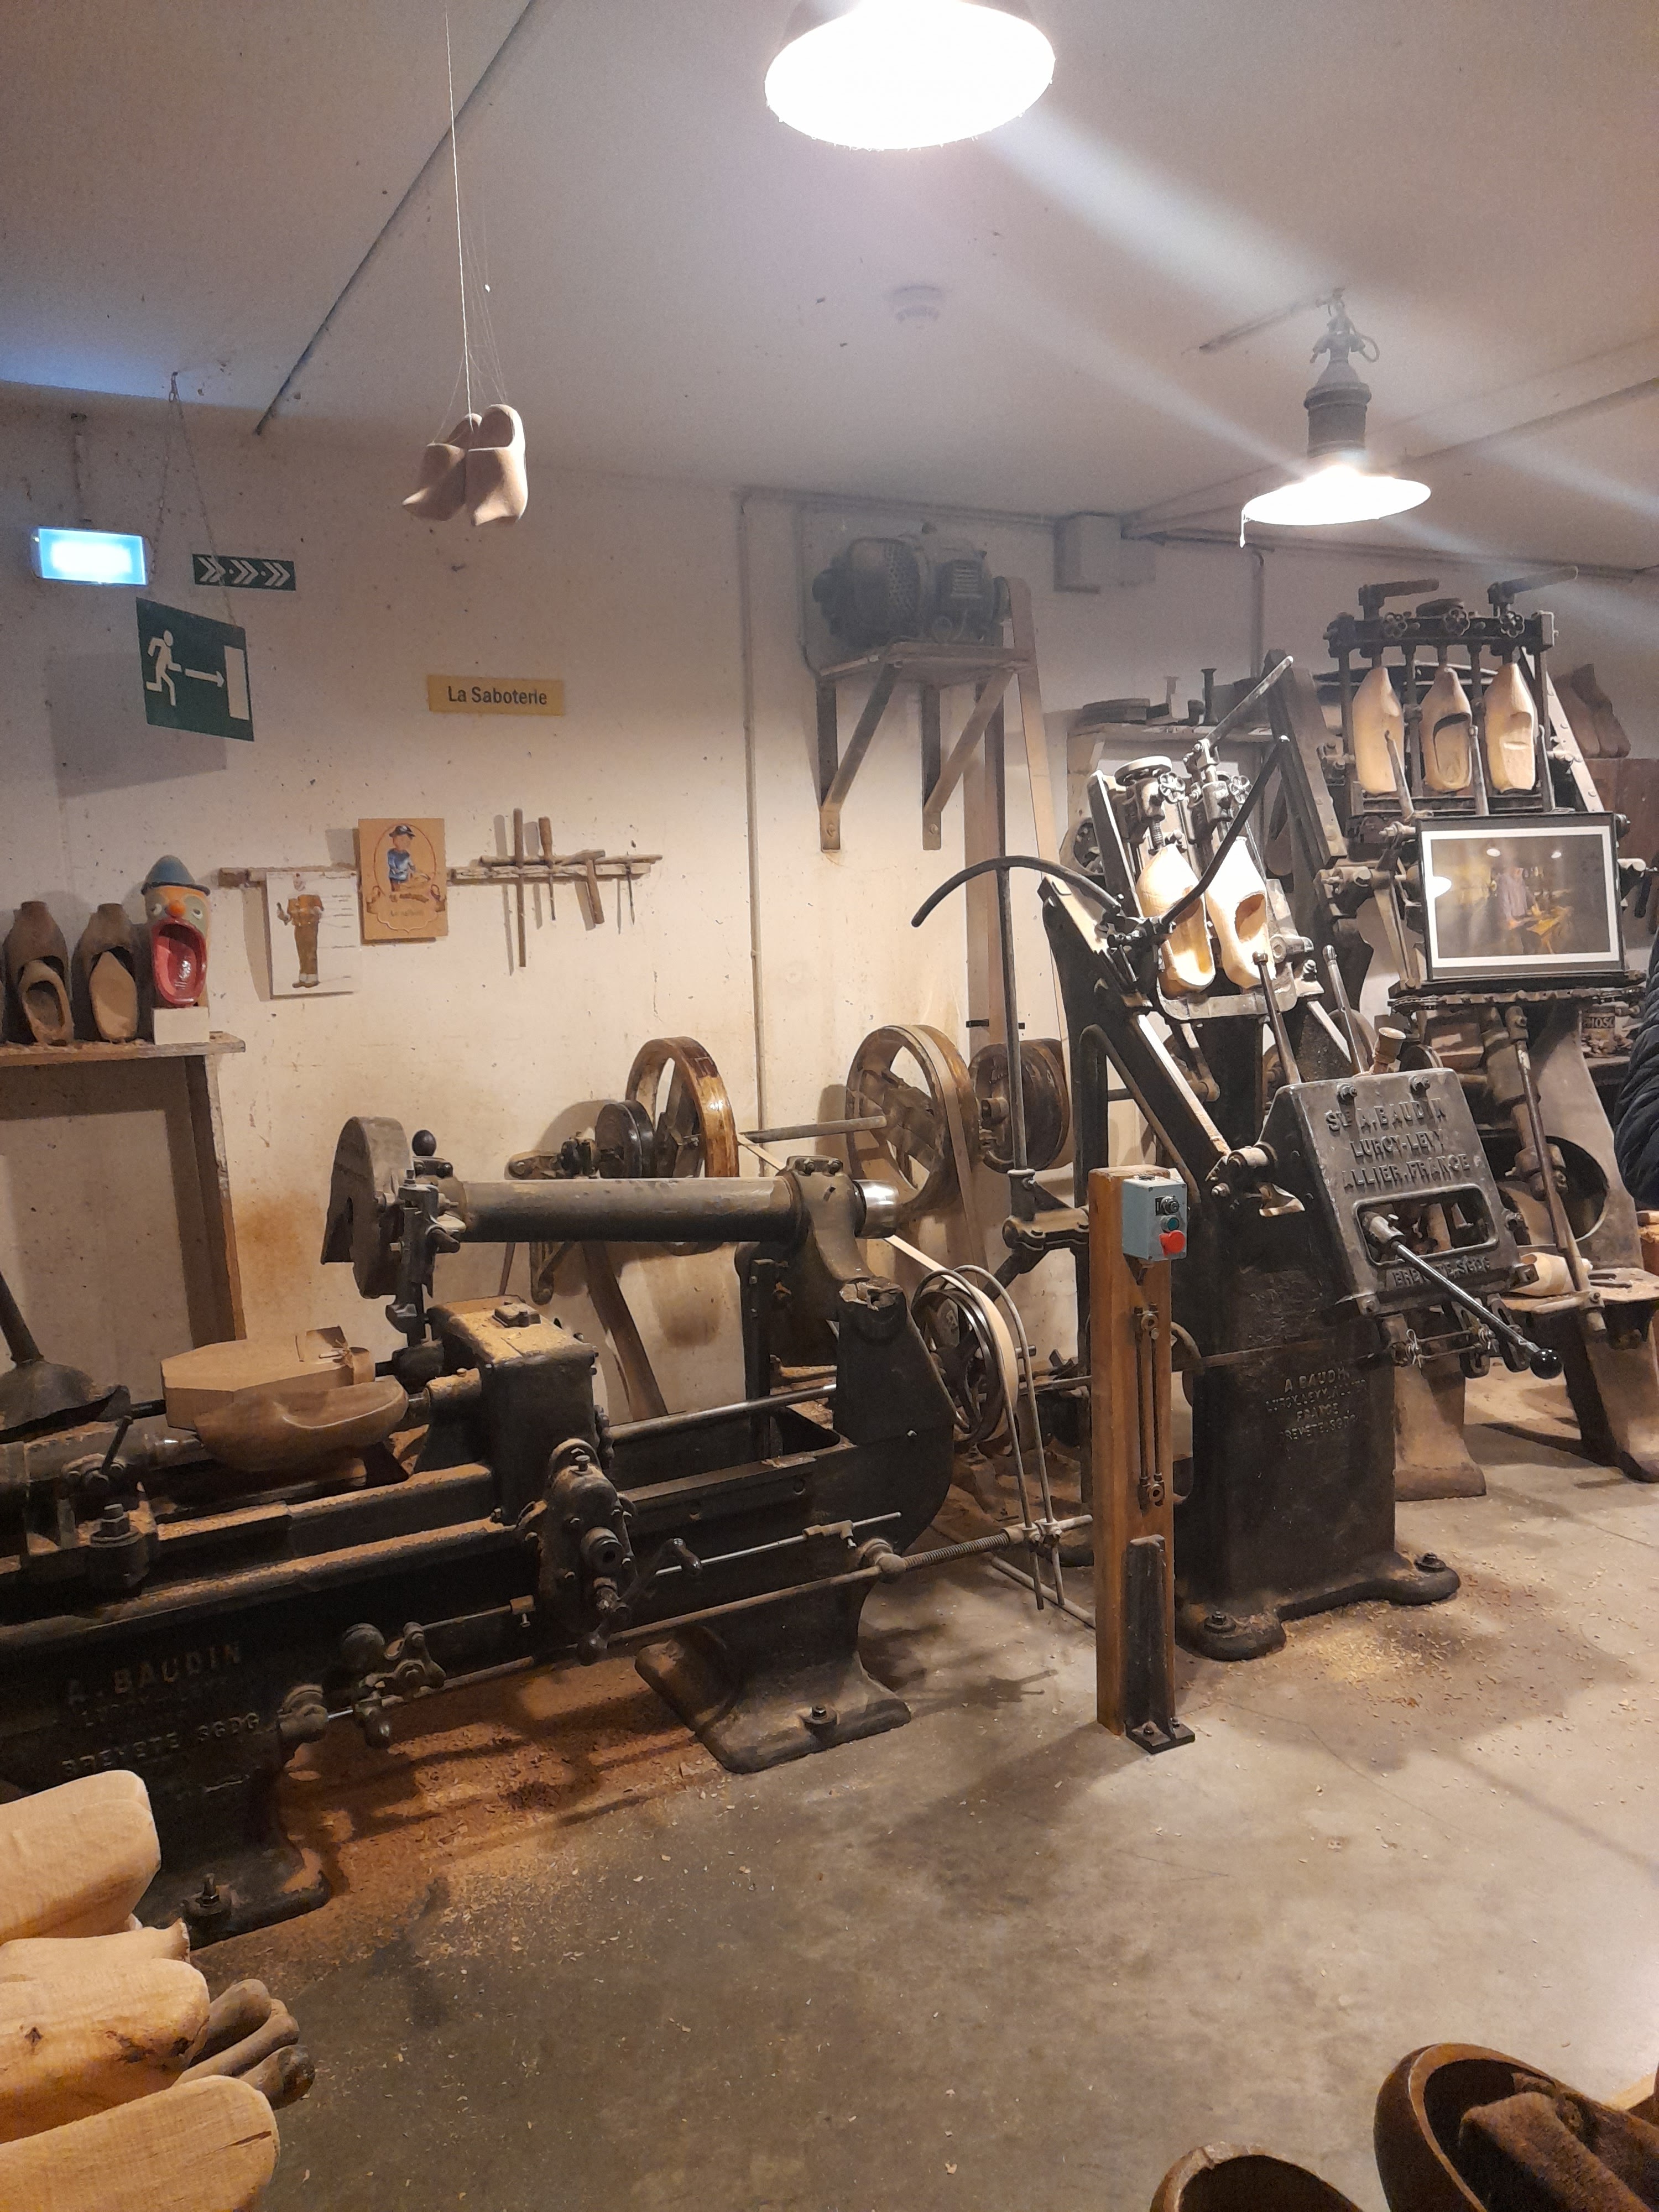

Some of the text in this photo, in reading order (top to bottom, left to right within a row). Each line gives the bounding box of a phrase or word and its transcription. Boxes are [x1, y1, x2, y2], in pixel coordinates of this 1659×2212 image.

[447, 685, 548, 705] La Saboterie
[113, 1640, 241, 1695] BAUDIN
